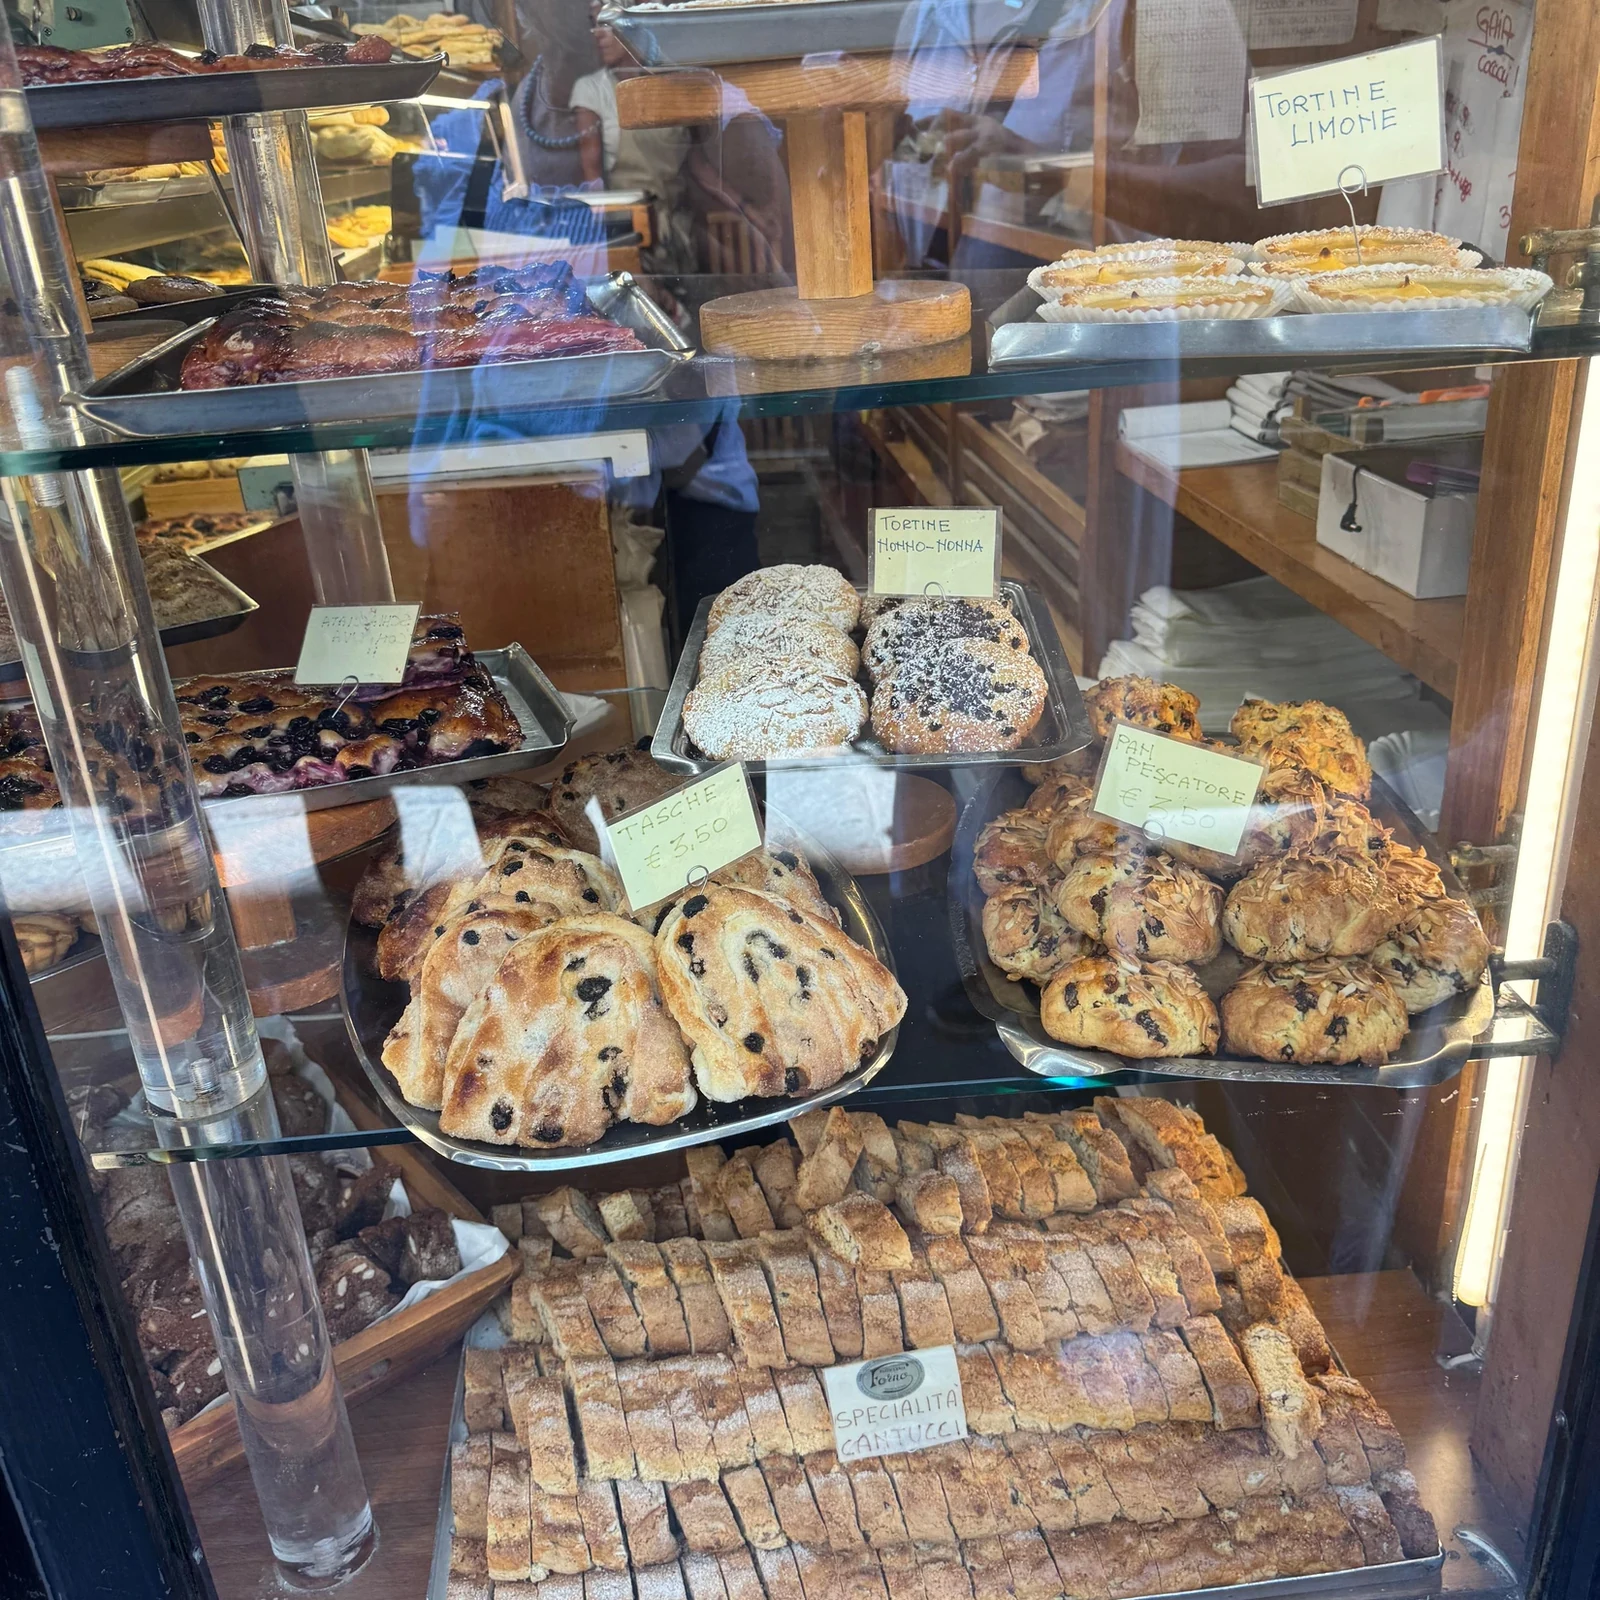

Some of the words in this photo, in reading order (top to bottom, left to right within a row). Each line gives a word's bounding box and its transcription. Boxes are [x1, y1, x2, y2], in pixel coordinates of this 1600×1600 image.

[1259, 80, 1386, 118] TORTINE
[1291, 107, 1398, 147] LIMONE
[880, 515, 951, 533] TORTINE
[877, 537, 984, 553] NONNO-NONNA
[1115, 733, 1155, 761] PAN
[1125, 756, 1247, 807] PESCATORE
[617, 783, 718, 841] TASCHE
[1118, 787, 1143, 808] €
[1148, 795, 1216, 829] 3,50
[643, 844, 662, 870] €
[669, 817, 728, 859] 3,50
[836, 1382, 959, 1429] SPECIALITÀ
[841, 1419, 961, 1457] CANTUCCI
